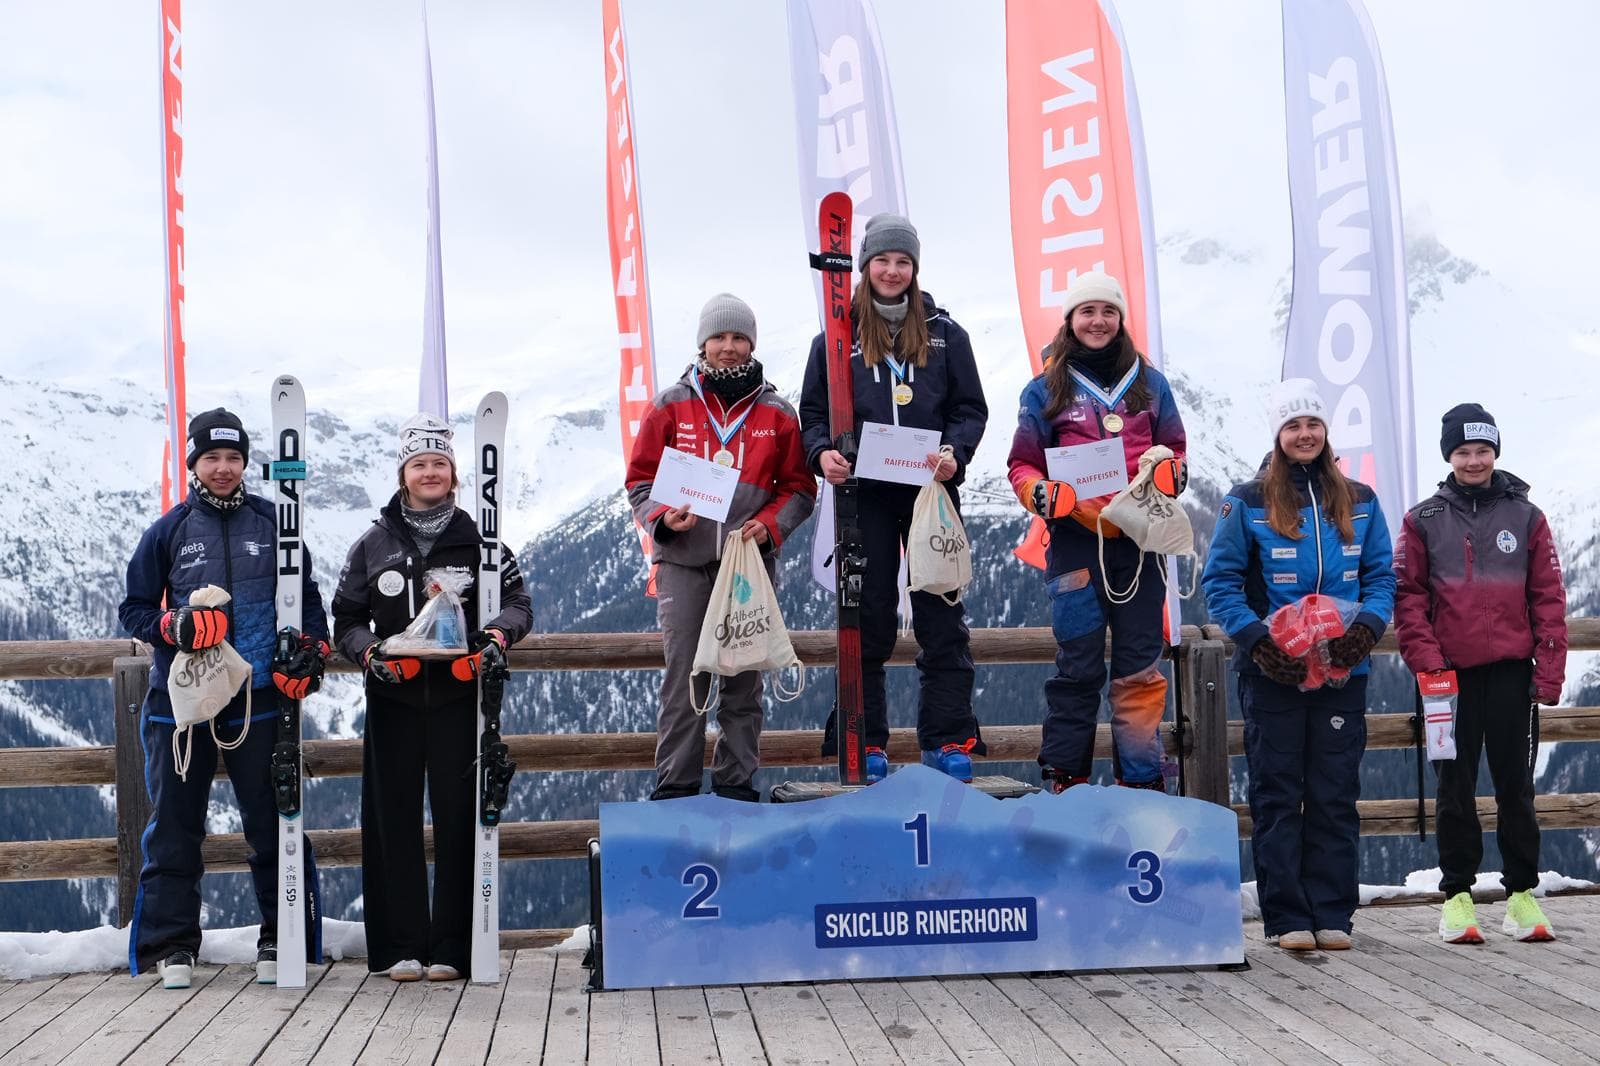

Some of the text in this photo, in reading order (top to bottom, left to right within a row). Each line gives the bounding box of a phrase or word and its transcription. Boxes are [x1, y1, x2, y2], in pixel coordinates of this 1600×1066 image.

[829, 212, 845, 321] STÖKLI
[884, 458, 929, 469] RAIFFEISEN
[1076, 469, 1119, 485] RAIFFEISEN
[280, 428, 299, 576] HEAD
[482, 444, 498, 572] HEAD
[680, 486, 723, 505] RAIFFEISEN
[180, 541, 206, 556] Beta
[731, 604, 765, 624] Albert
[175, 647, 224, 688] Spie
[904, 813, 928, 866] 1
[682, 864, 720, 918] 2
[1127, 850, 1164, 904] 3
[825, 907, 1028, 939] SKICLUB RINERHORN
